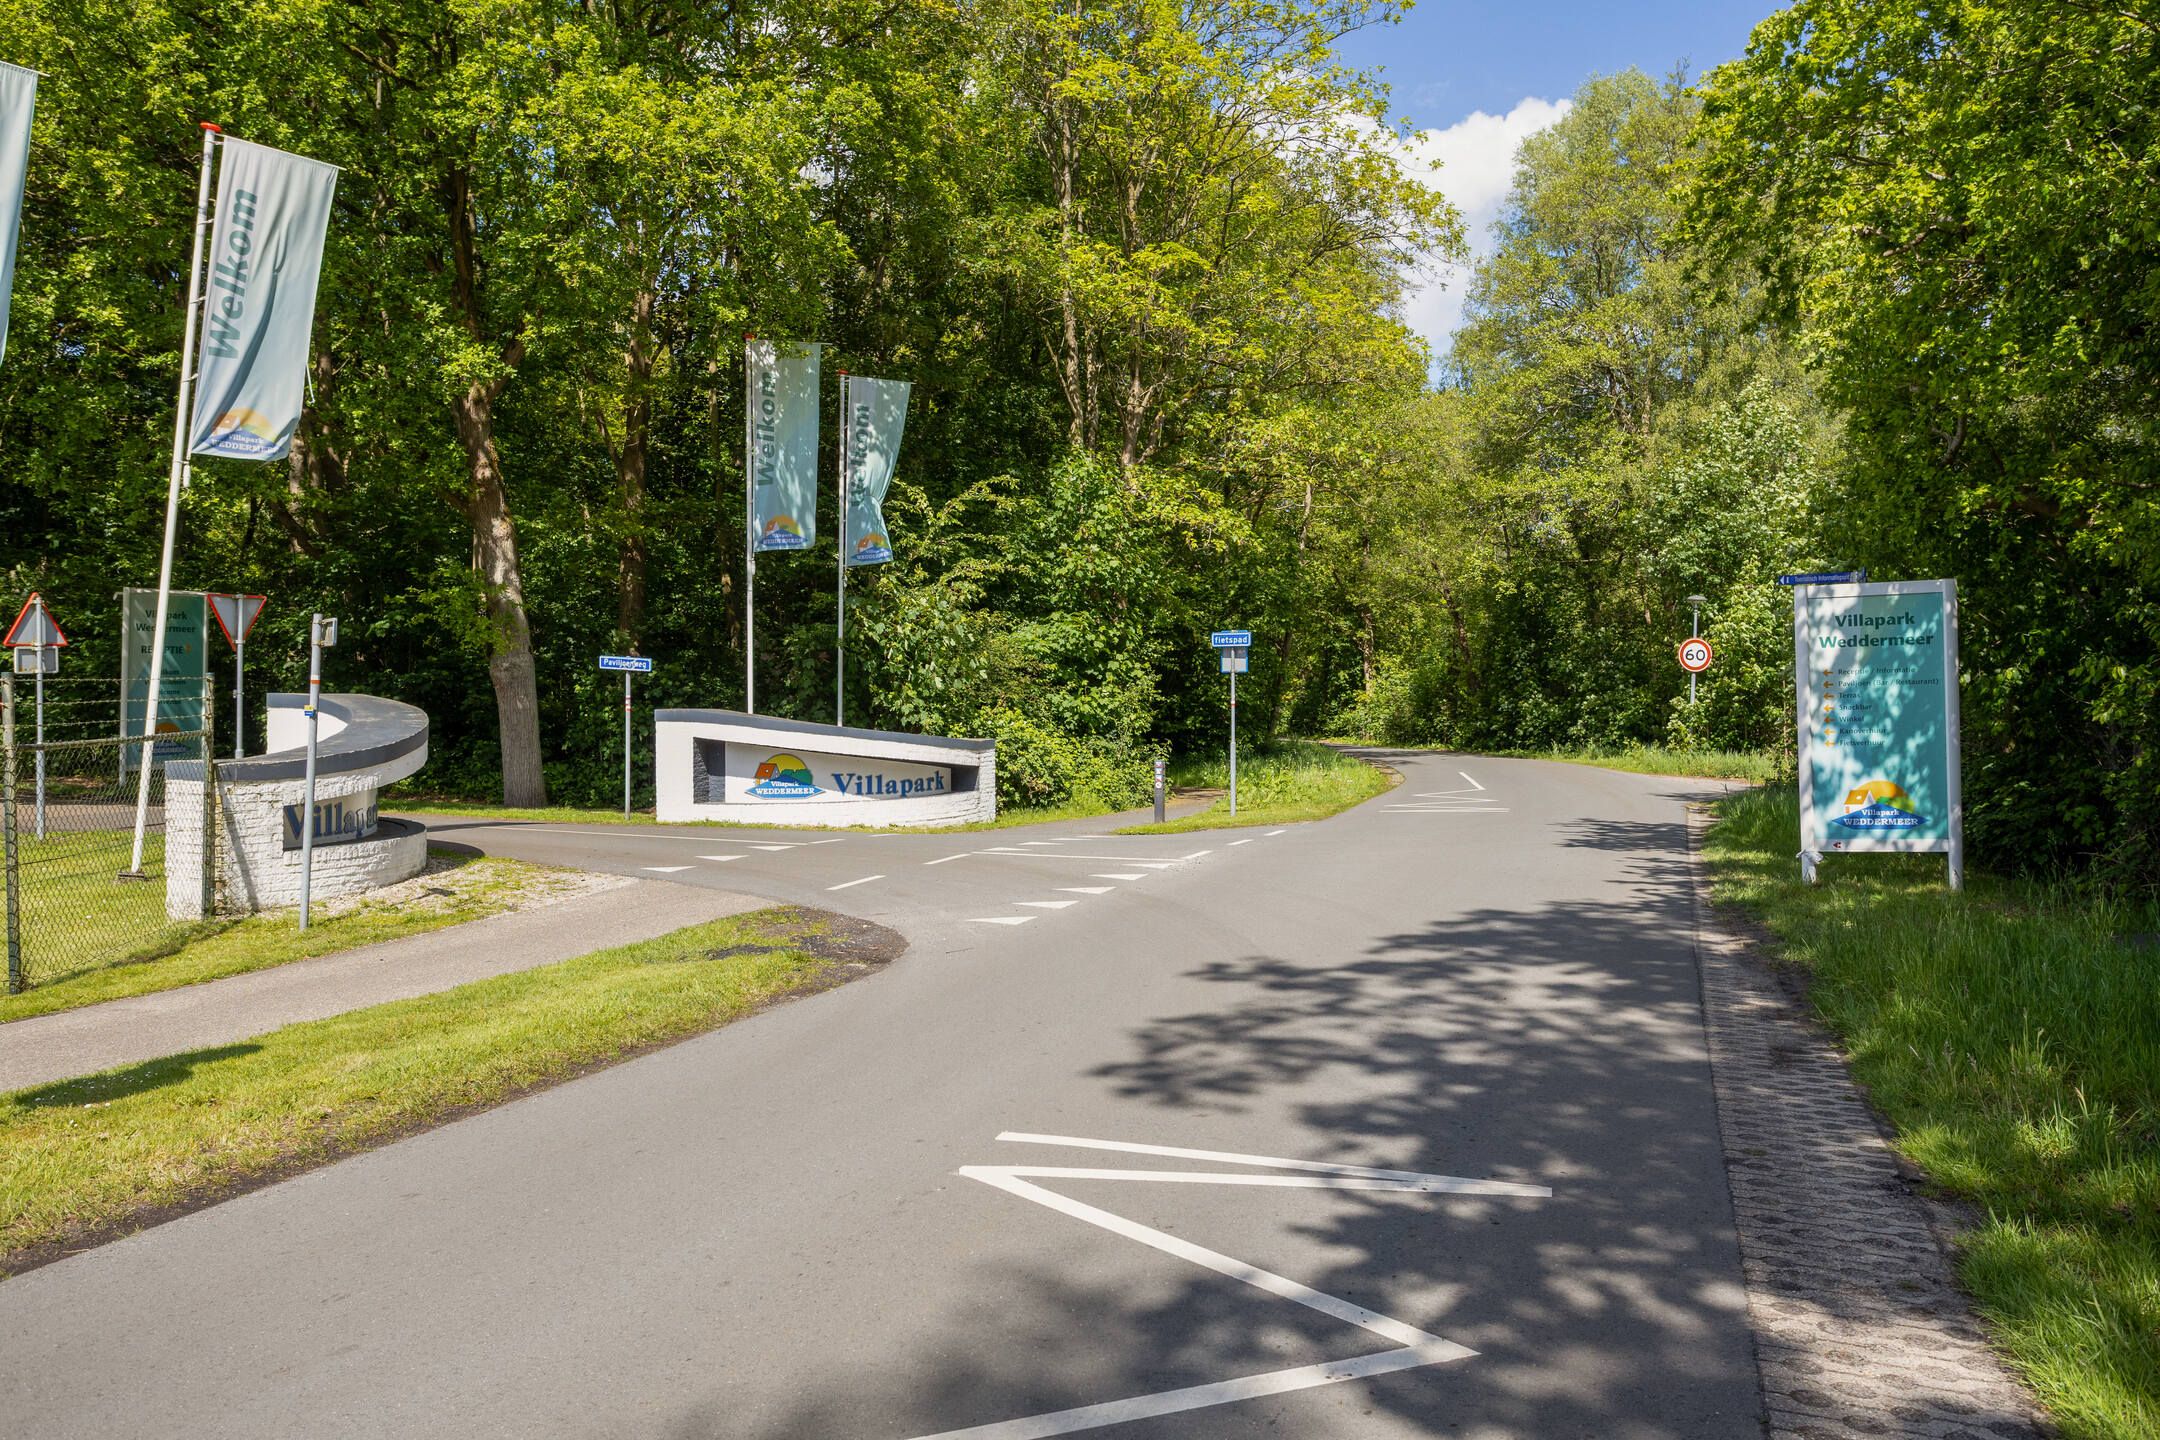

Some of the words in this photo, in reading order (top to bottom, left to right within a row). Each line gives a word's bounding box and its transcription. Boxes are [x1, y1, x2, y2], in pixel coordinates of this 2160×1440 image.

[208, 188, 258, 359] Welkom
[757, 372, 776, 486] Welkom
[1835, 611, 1915, 630] Villapark
[1819, 634, 1934, 648] Weddermeer
[141, 645, 184, 654] REPTIE
[1685, 649, 1706, 661] 60
[1896, 678, 1939, 686] Restaurant)
[771, 780, 800, 788] Villapark
[830, 770, 945, 798] Villapark
[755, 787, 815, 796] WEDDERMEER
[1861, 808, 1900, 817] Villapark
[1844, 817, 1918, 826] WEDDERMEER
